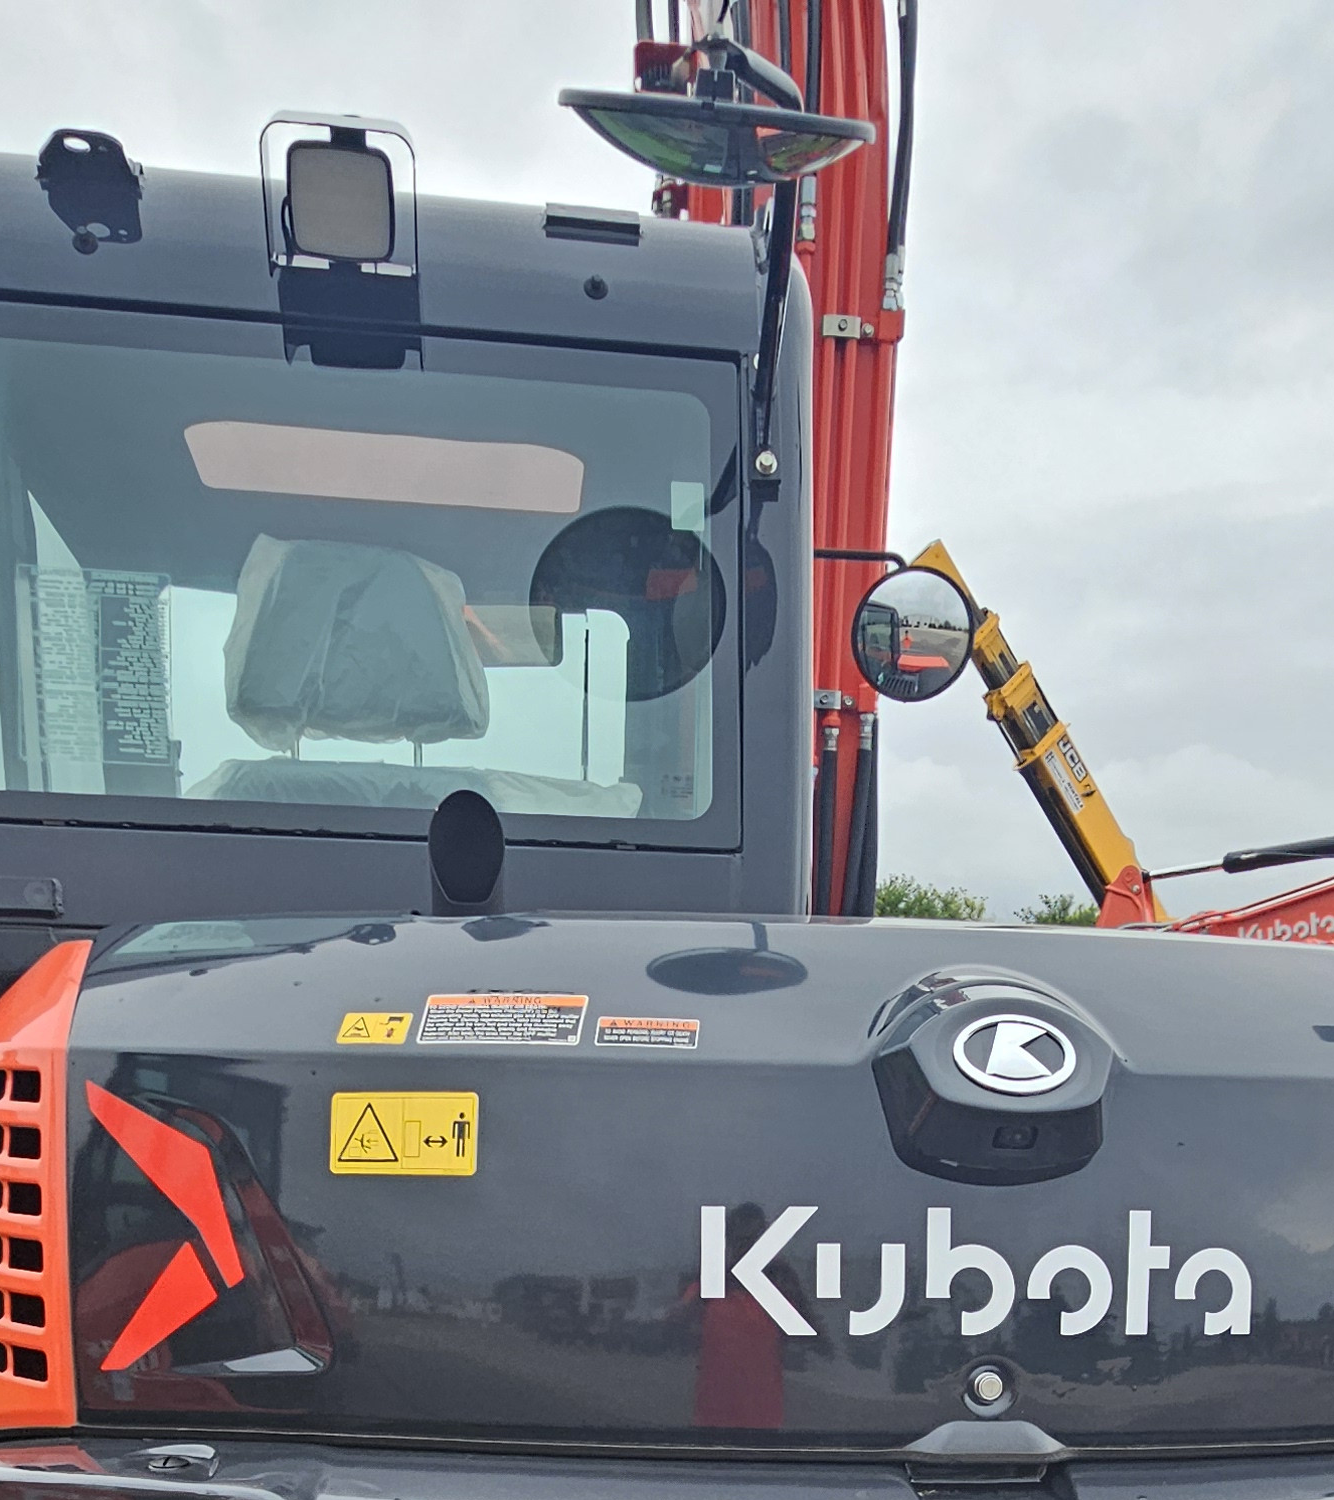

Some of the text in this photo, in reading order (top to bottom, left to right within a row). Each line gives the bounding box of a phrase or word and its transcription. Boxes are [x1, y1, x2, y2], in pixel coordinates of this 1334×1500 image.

[1057, 733, 1088, 783] JCB
[483, 995, 542, 1005] WARNING
[623, 1018, 691, 1030] WARNING
[700, 1205, 1252, 1336] Kubota
